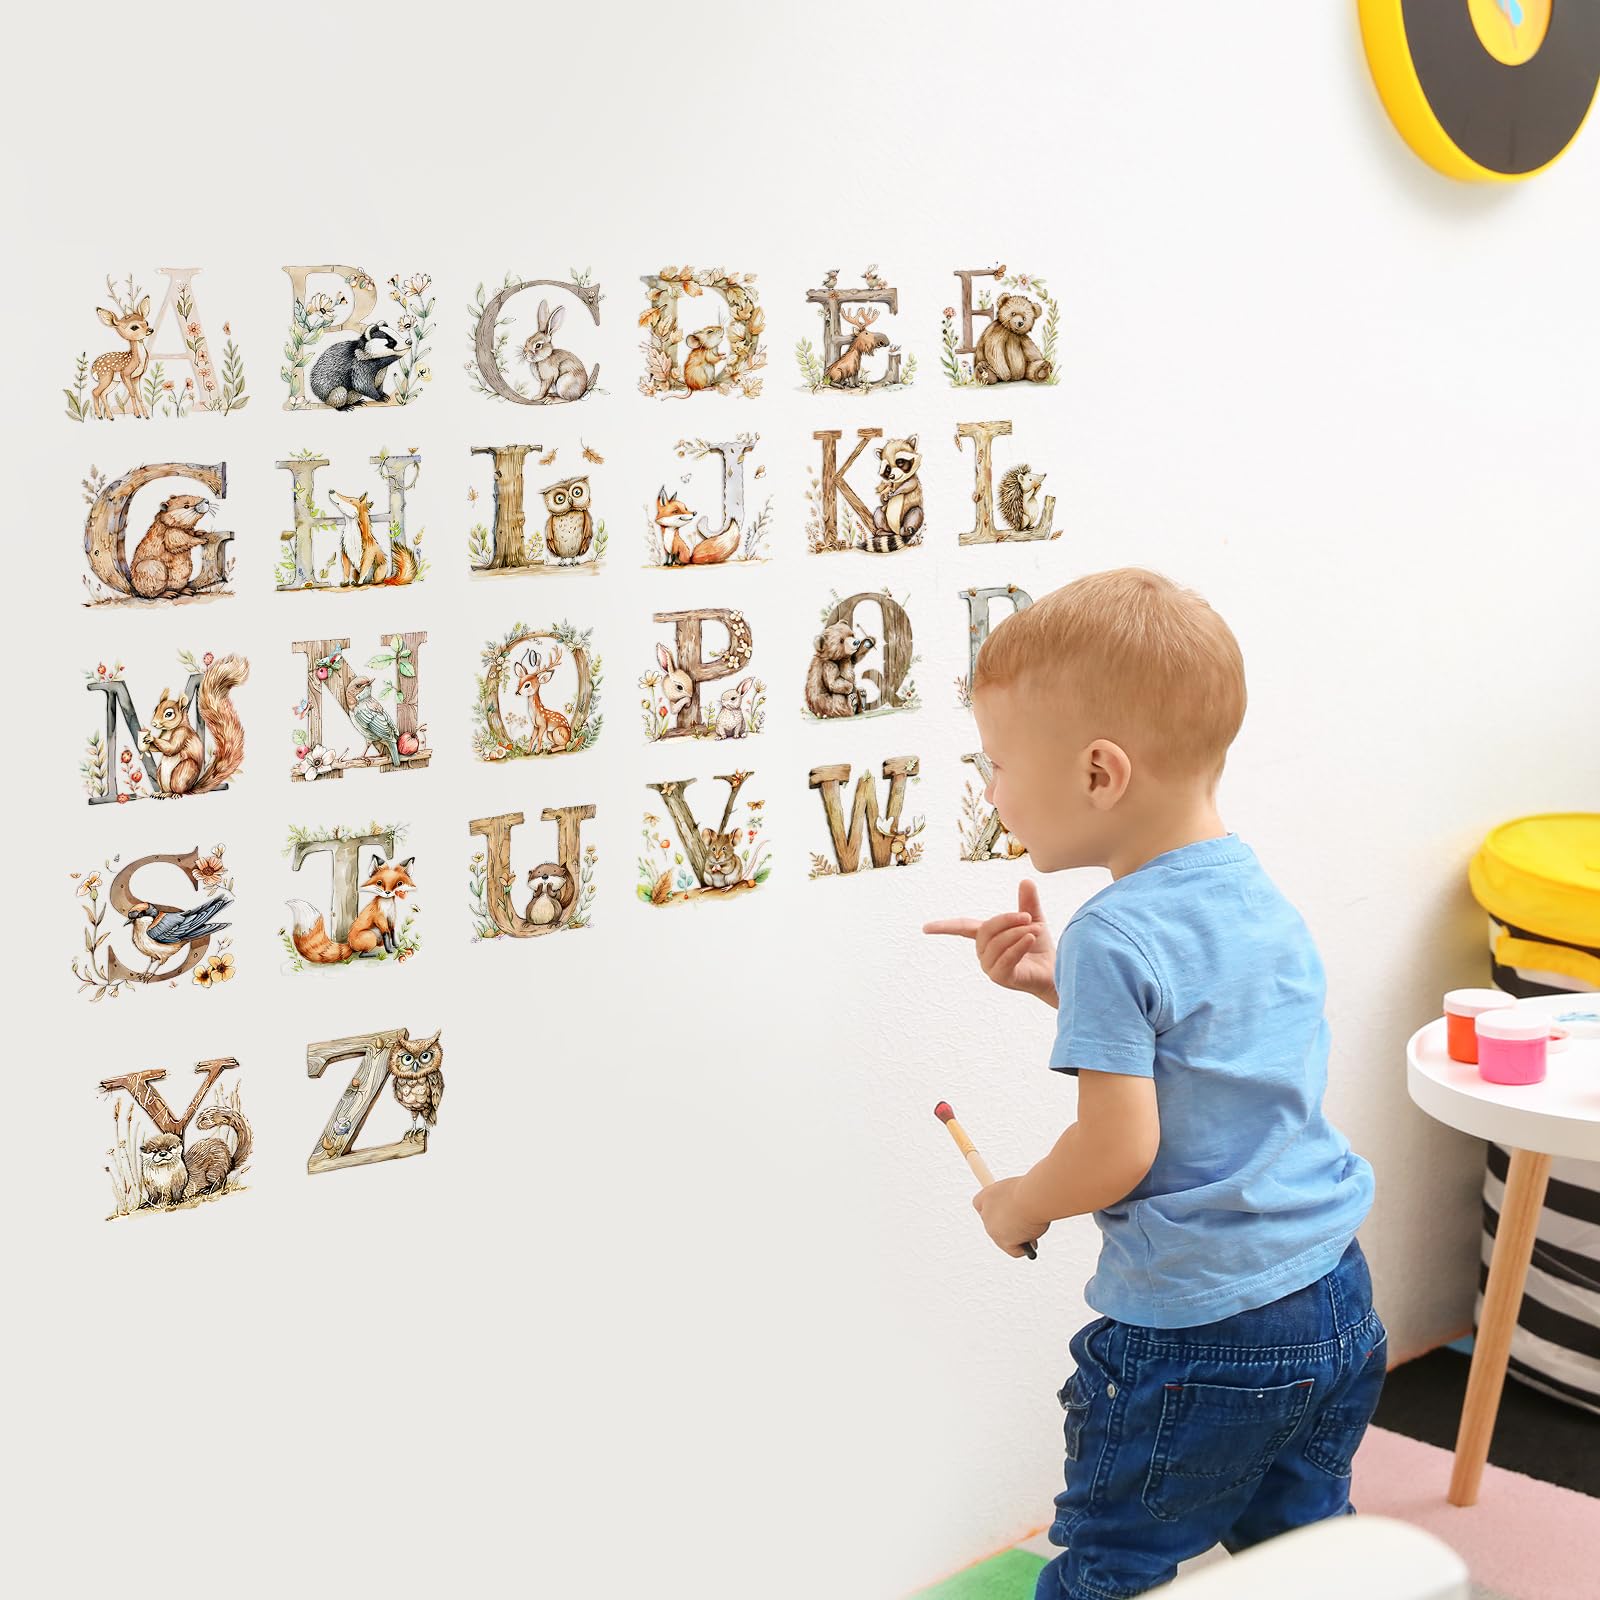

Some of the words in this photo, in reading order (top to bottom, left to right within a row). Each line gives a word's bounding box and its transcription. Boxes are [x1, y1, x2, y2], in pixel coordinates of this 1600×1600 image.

[112, 267, 240, 414] A
[282, 264, 407, 411] B
[476, 279, 600, 405] C
[640, 273, 761, 391] D
[806, 287, 902, 386] E
[953, 269, 1006, 354] F
[84, 461, 235, 600] G
[275, 455, 422, 591] H
[470, 444, 543, 570] I
[697, 441, 754, 539] J
[813, 427, 885, 552] K
[956, 420, 1056, 546] L
[87, 673, 229, 806] M
[291, 631, 433, 783] N
[486, 629, 593, 756] O
[653, 608, 753, 740] P
[107, 846, 214, 983] S
[291, 831, 395, 943] T
[469, 804, 597, 938] U
[646, 771, 755, 890] V
[809, 756, 920, 874] W
[99, 1057, 240, 1146] Y
[307, 1028, 429, 1175] Z
